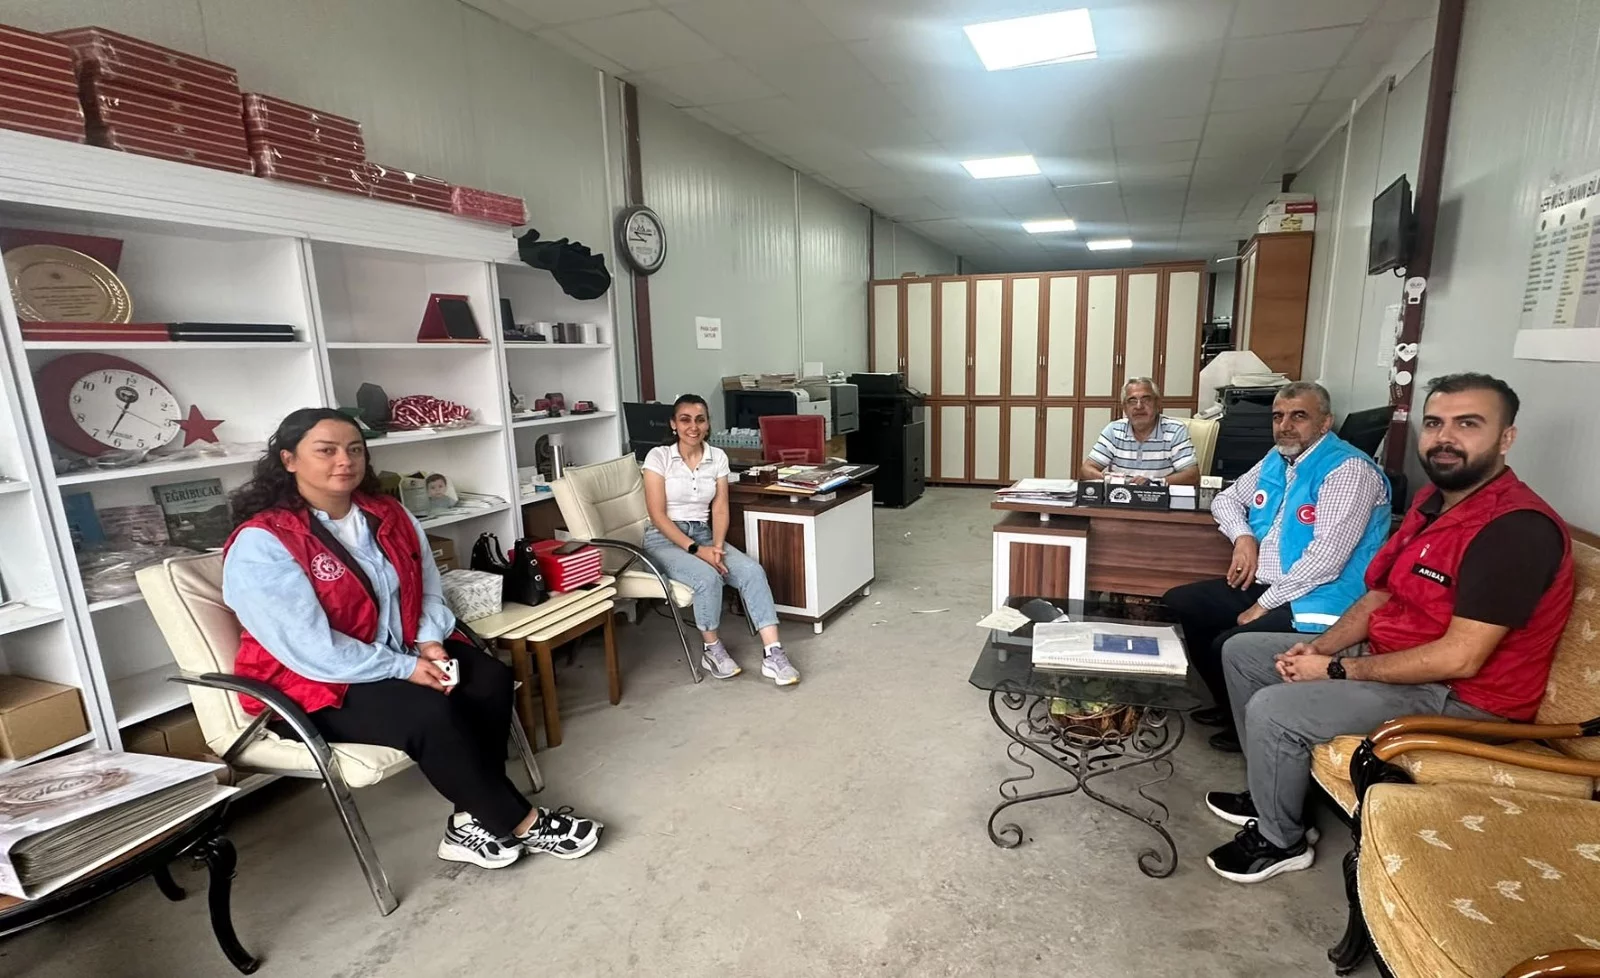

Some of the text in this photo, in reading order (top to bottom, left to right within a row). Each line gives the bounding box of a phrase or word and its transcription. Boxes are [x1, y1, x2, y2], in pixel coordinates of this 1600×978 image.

[104, 375, 112, 384] 11
[126, 377, 137, 387] 12
[82, 381, 95, 391] 10
[73, 394, 81, 404] 9
[160, 402, 168, 411] 2
[77, 414, 86, 423] 8
[163, 419, 171, 427] 3
[92, 428, 99, 437] 7
[155, 433, 162, 441] 4
[113, 438, 121, 447] 6
[136, 439, 144, 448] 5
[164, 485, 222, 503] EĞRİBUCAK
